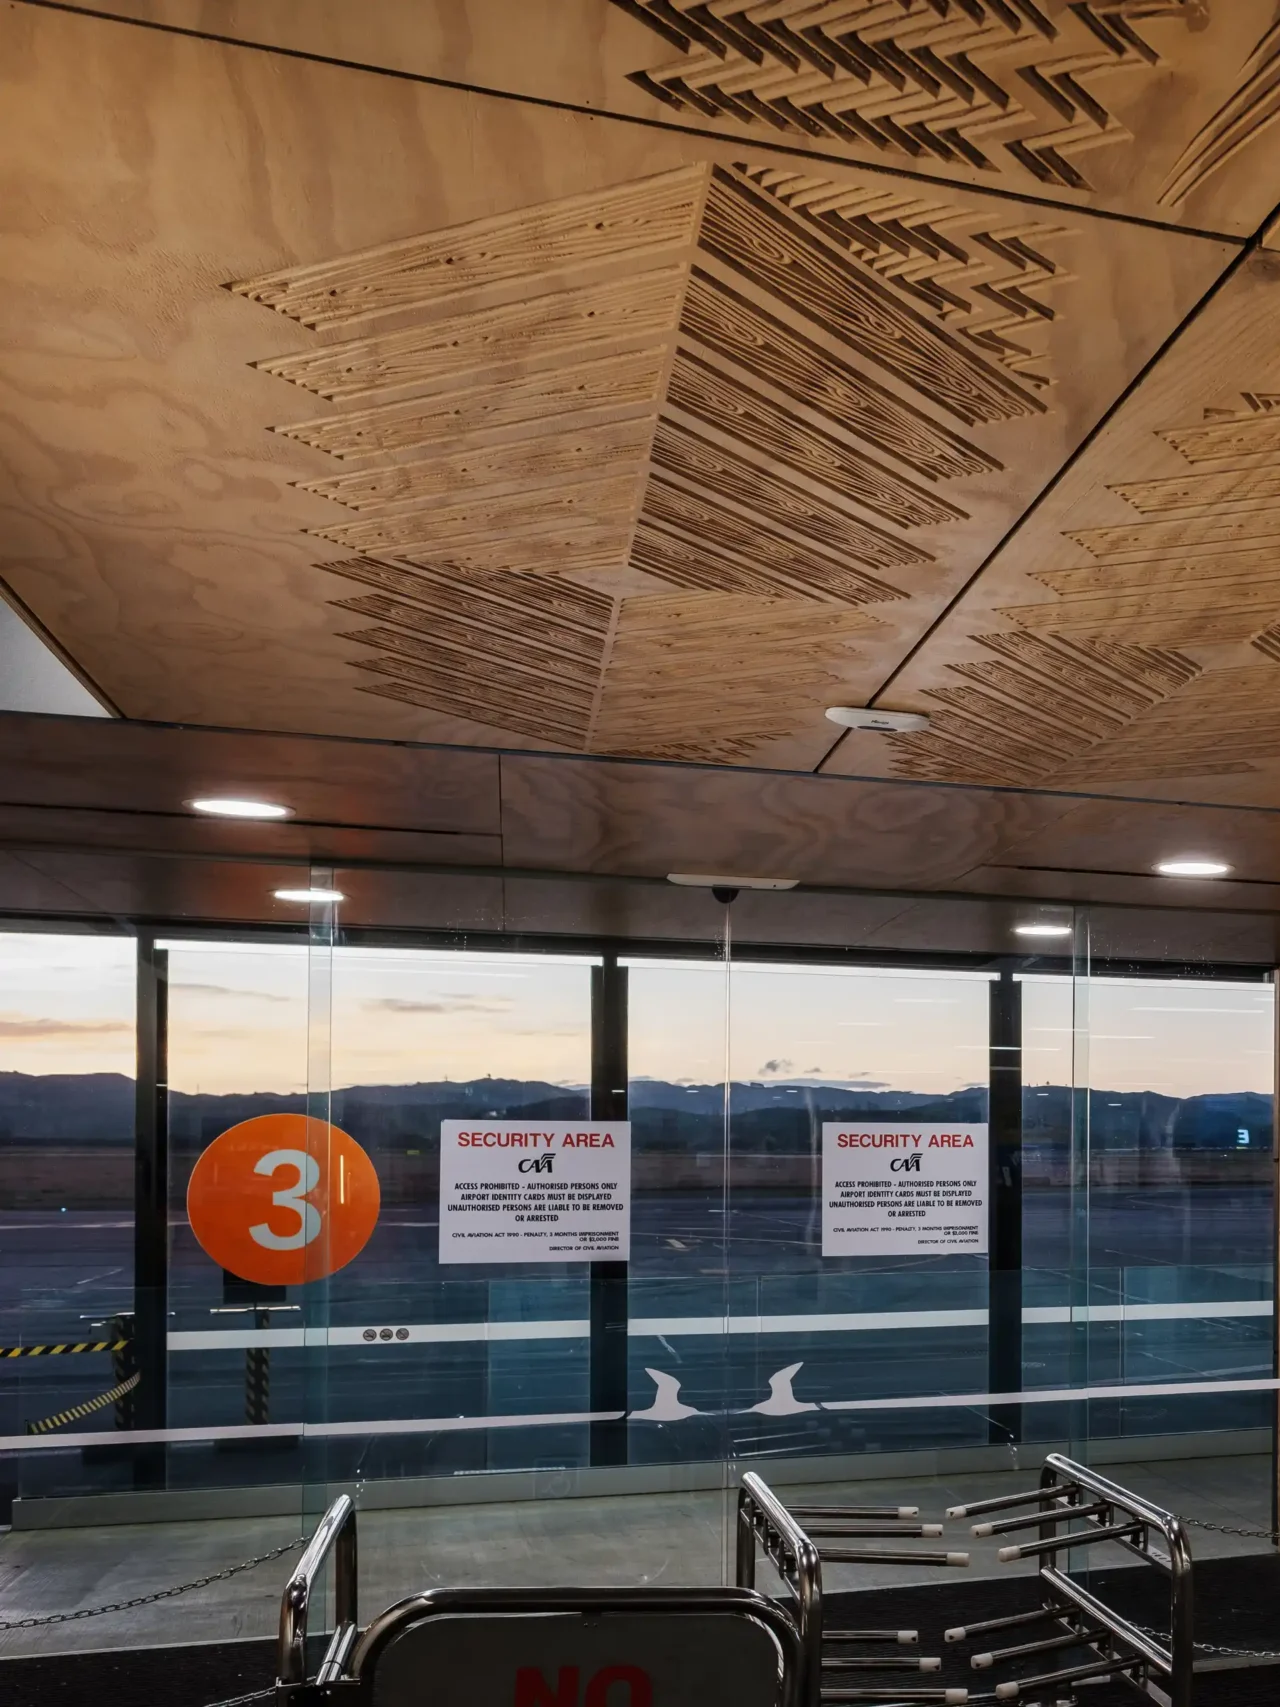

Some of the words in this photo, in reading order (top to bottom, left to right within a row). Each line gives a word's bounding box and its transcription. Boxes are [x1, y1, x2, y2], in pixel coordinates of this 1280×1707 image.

[458, 1132, 555, 1147] SECURITY
[562, 1133, 615, 1147] AREA
[837, 1134, 922, 1147] SECURITY
[928, 1134, 974, 1147] AREA
[518, 1153, 556, 1173] CAA
[890, 1153, 923, 1172] CAA
[248, 1149, 322, 1251] 3
